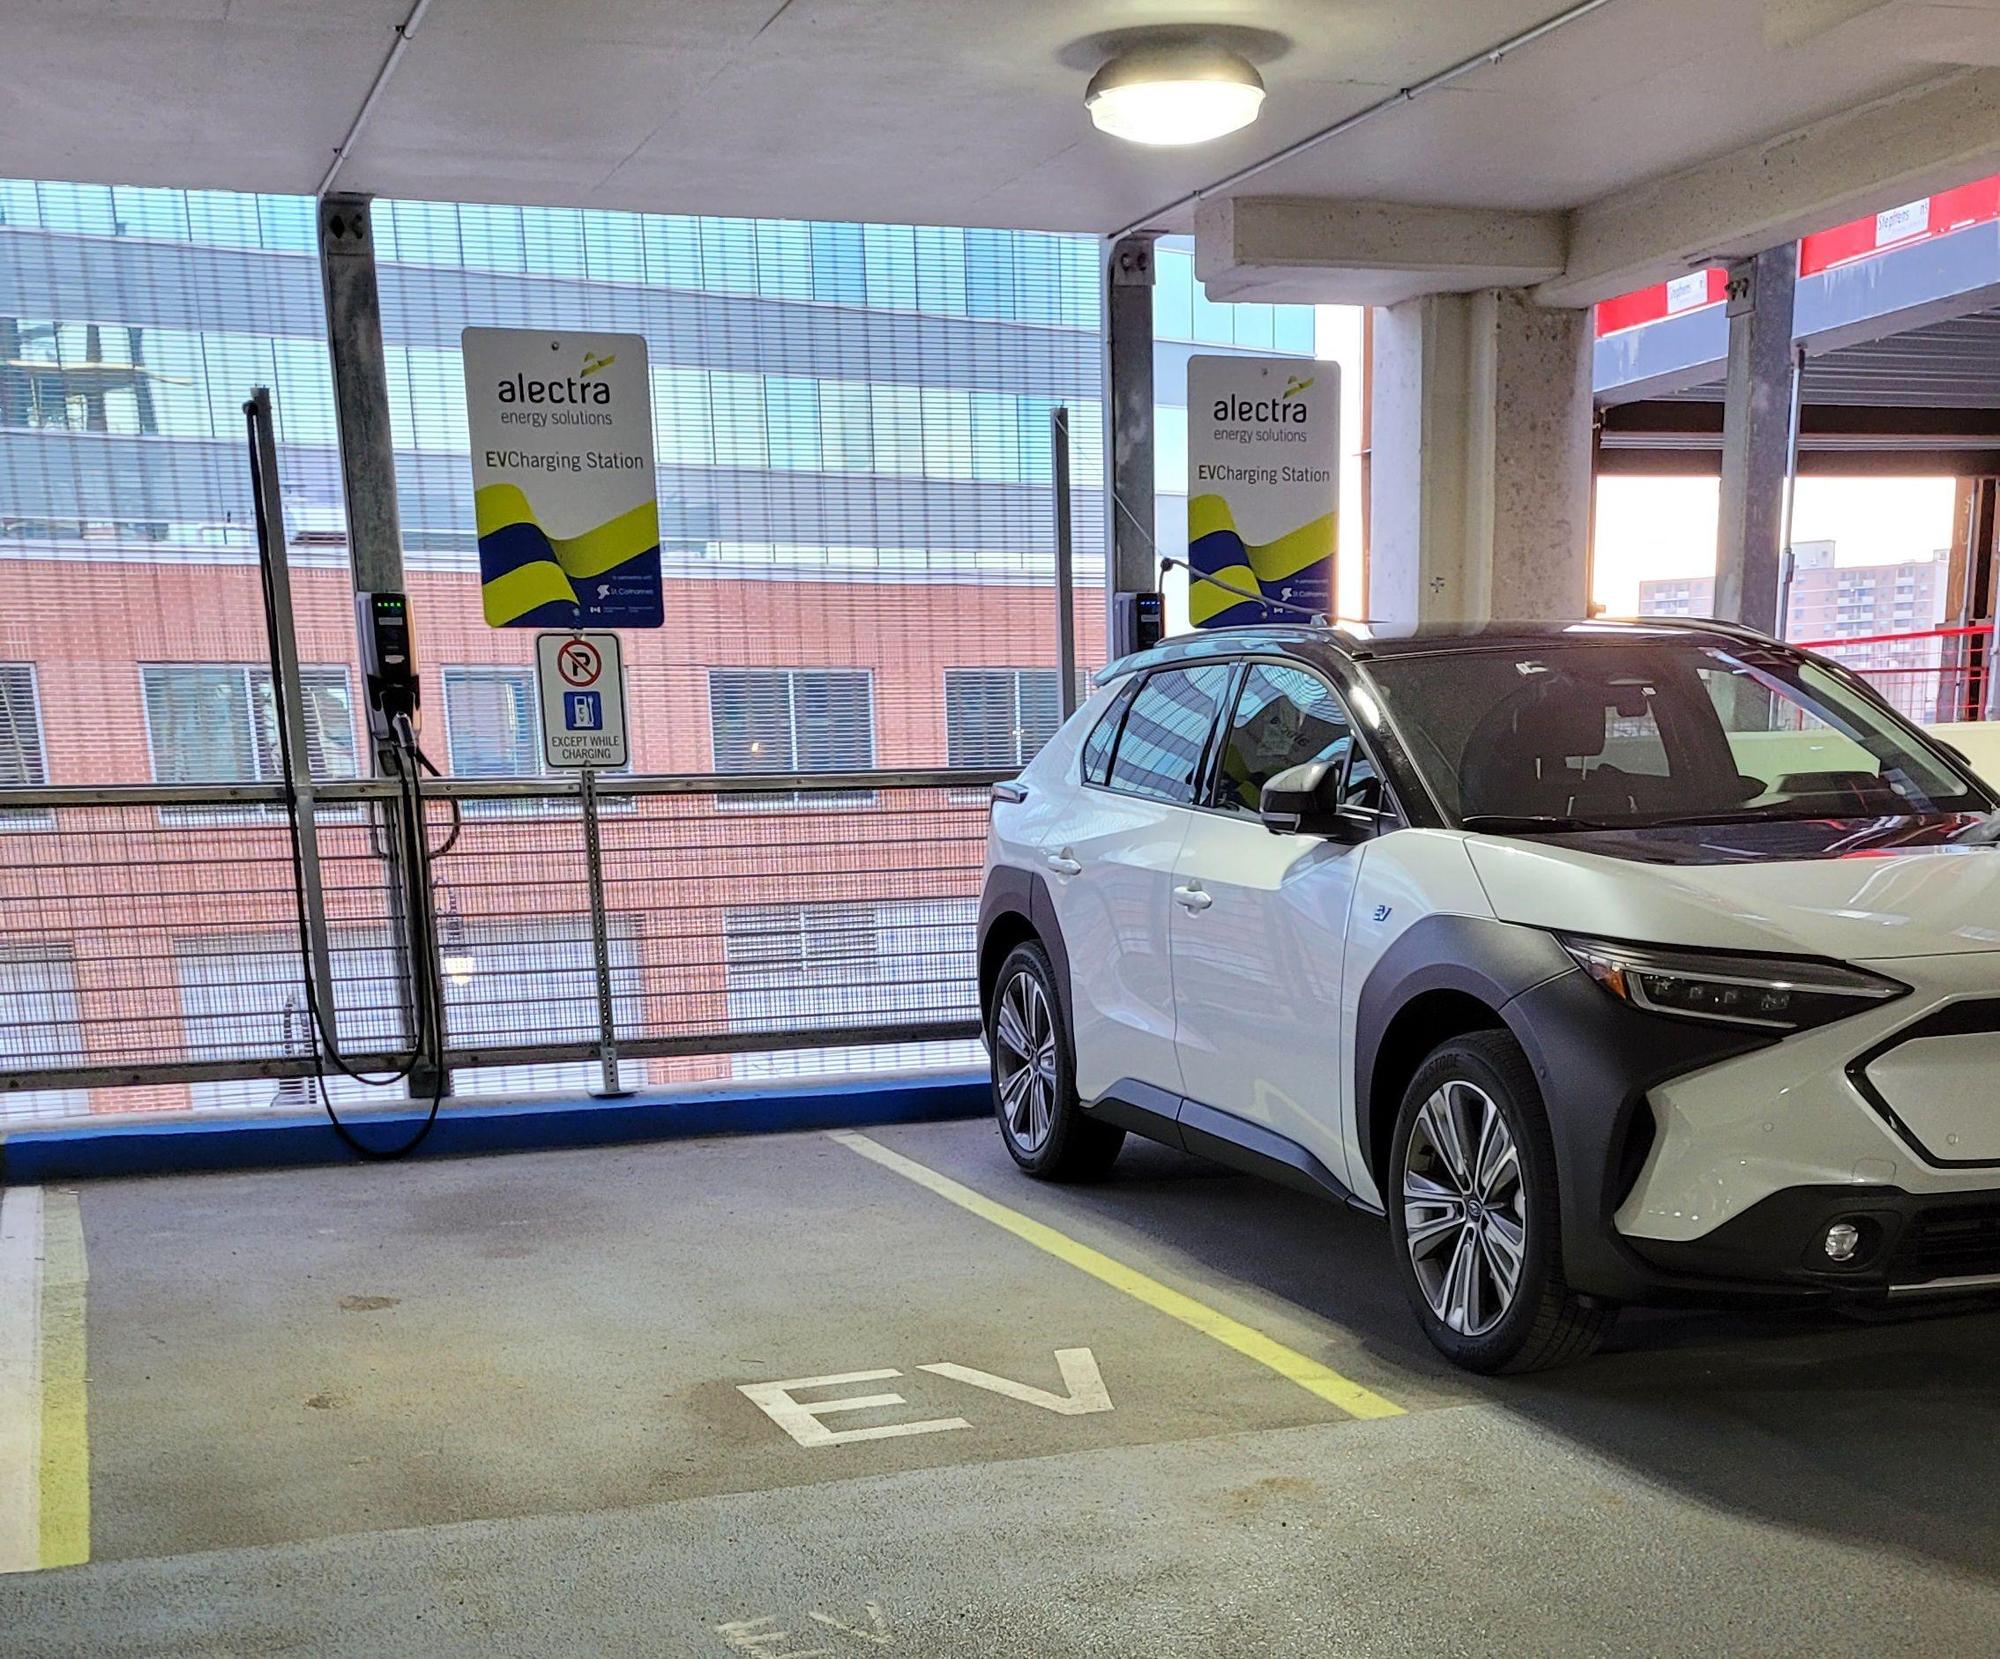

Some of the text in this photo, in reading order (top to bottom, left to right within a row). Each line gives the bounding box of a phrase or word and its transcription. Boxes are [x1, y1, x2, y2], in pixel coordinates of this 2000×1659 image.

[498, 373, 610, 404] alectra
[1213, 394, 1307, 423] alectra
[501, 411, 613, 427] energy solutions
[1213, 428, 1307, 443] energy solutions
[586, 451, 643, 469] Station
[1282, 466, 1330, 482] Station
[551, 735, 620, 747] EXCEPT WHILE
[562, 748, 611, 759] CHARGING
[736, 1347, 1114, 1448] EV
